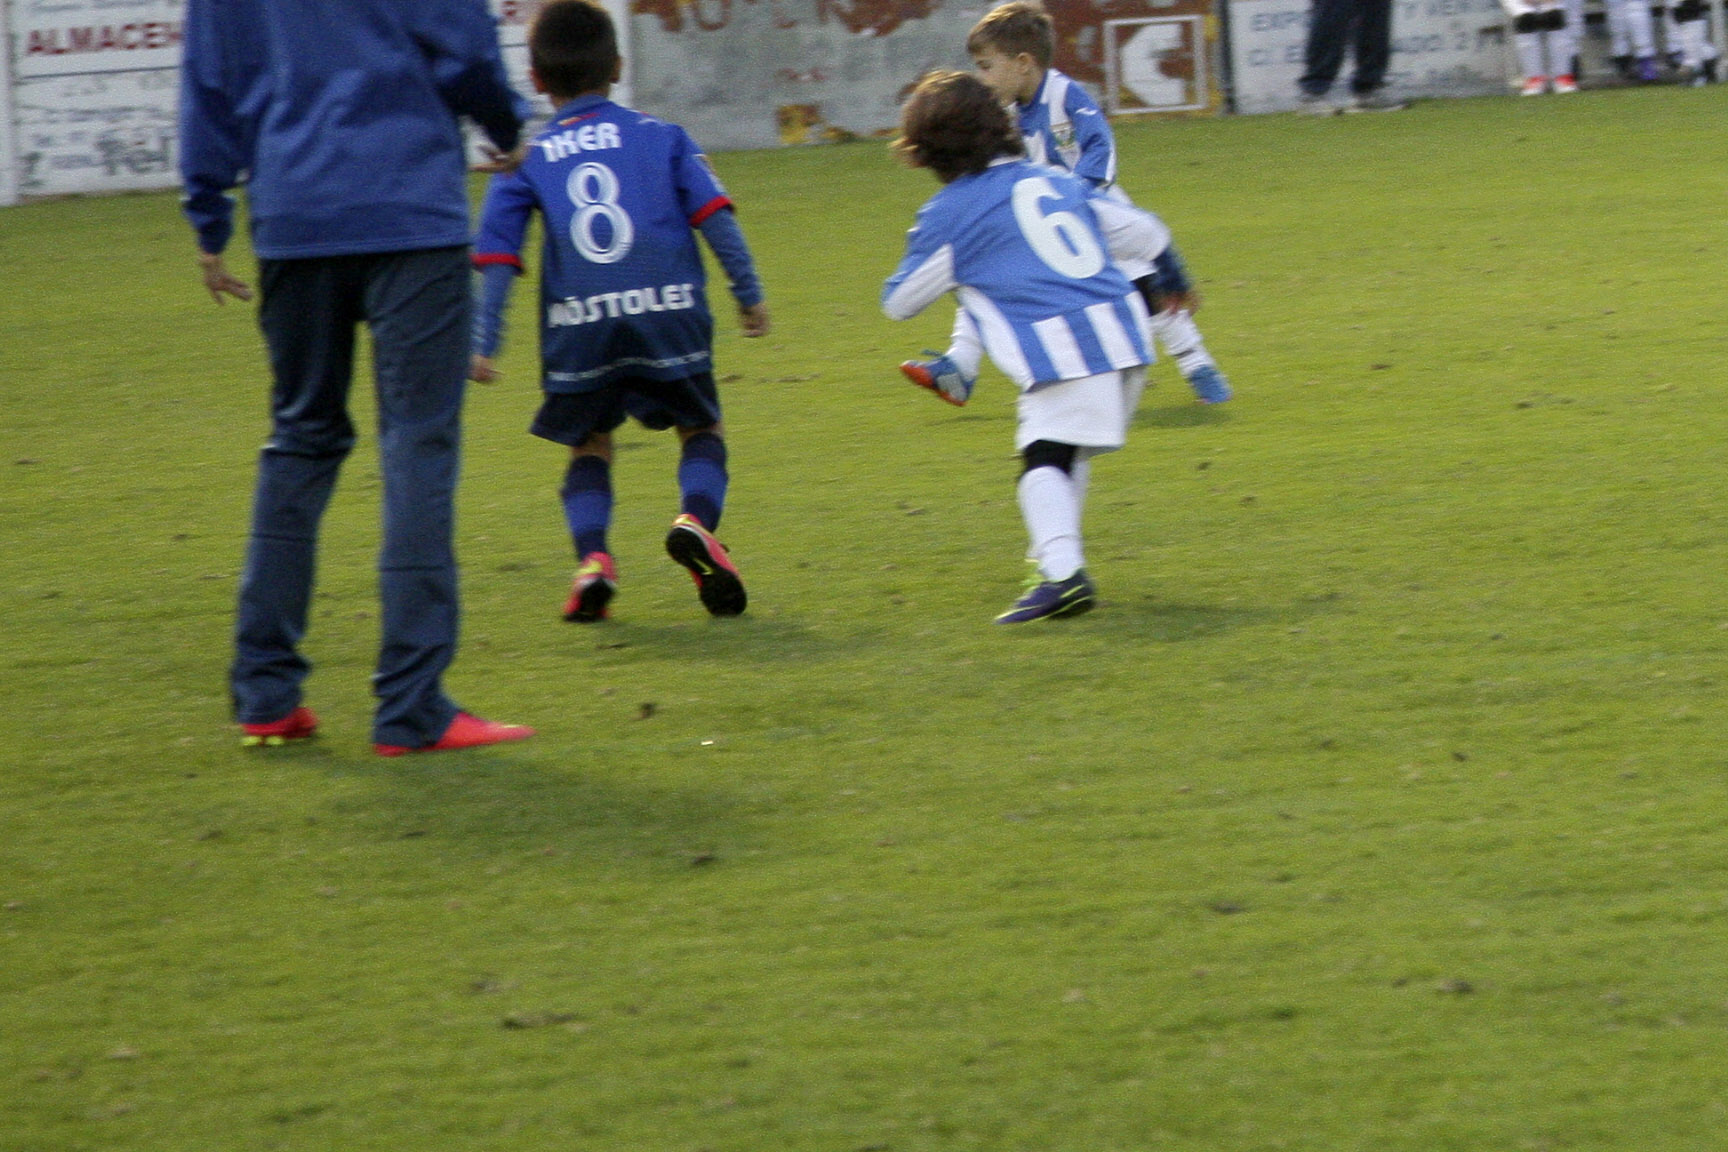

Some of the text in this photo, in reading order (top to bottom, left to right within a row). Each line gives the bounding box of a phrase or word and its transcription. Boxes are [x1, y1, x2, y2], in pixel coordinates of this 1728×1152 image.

[540, 121, 623, 163] IKER
[566, 161, 635, 264] 8
[1010, 176, 1106, 280] 6
